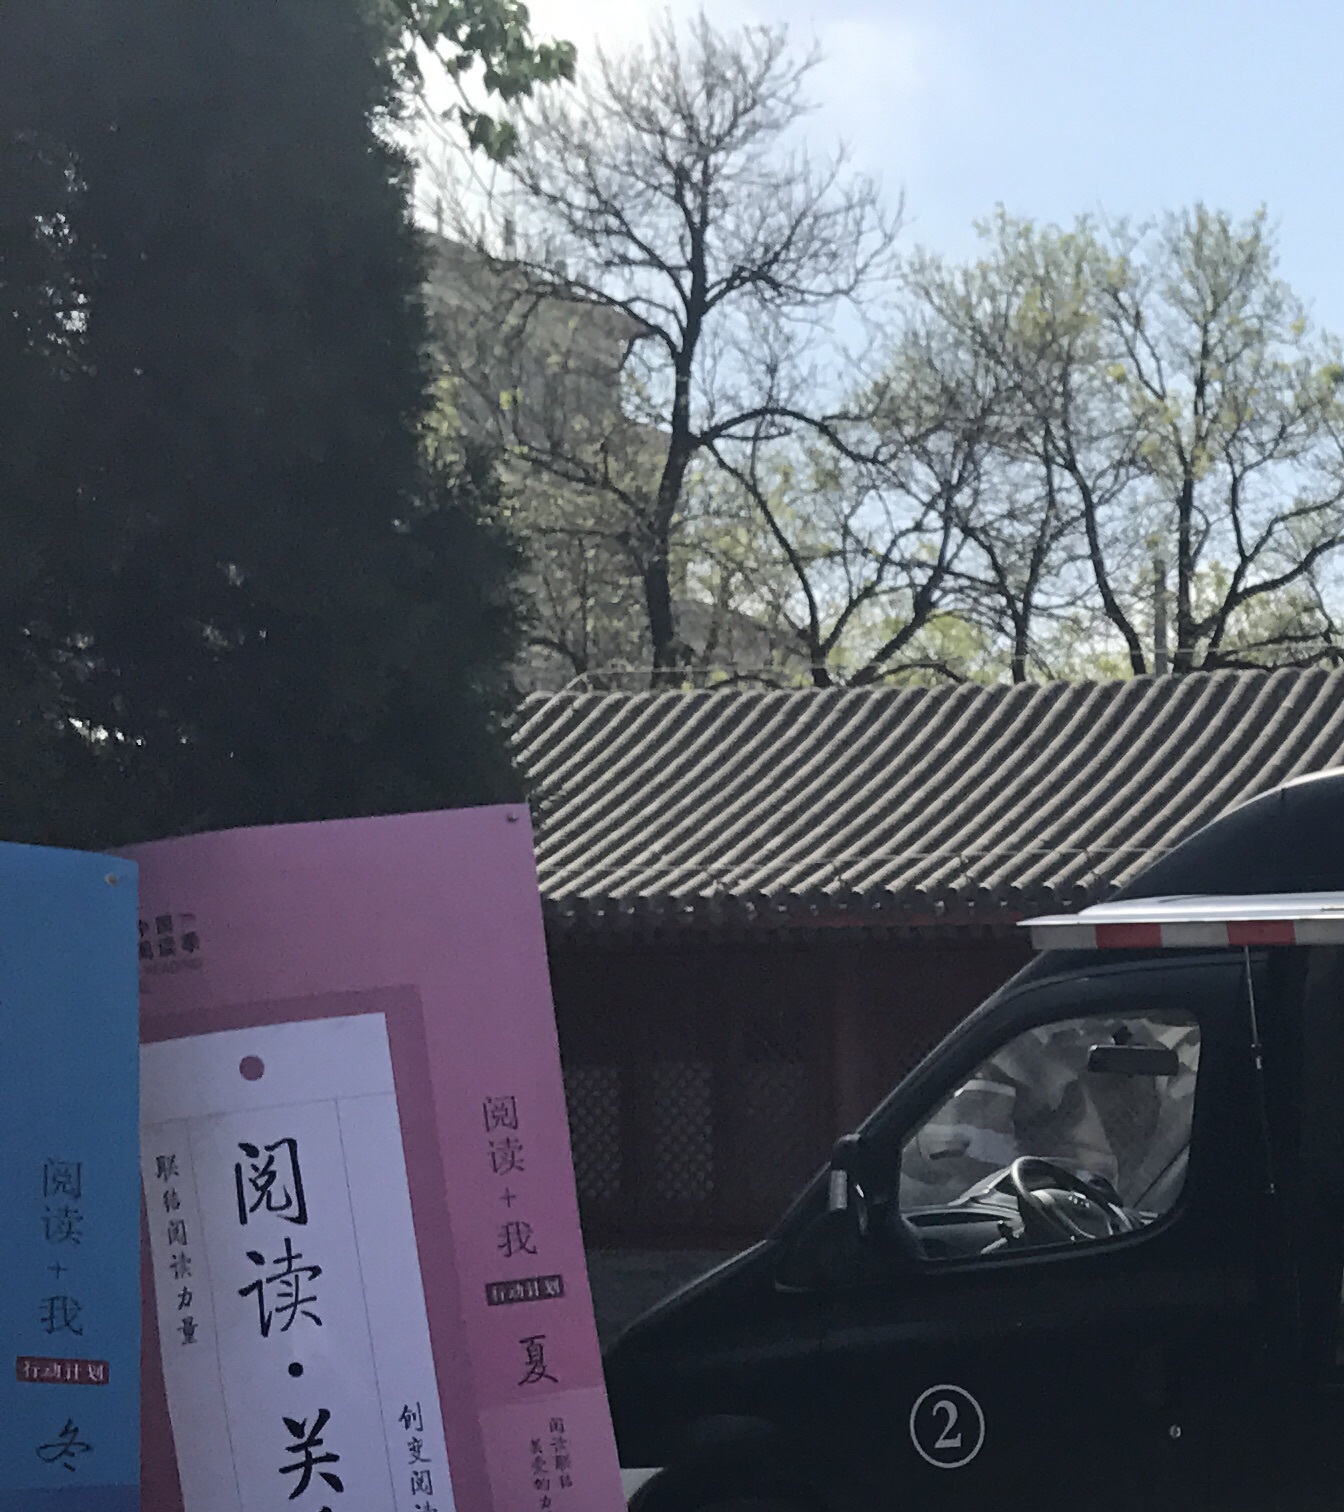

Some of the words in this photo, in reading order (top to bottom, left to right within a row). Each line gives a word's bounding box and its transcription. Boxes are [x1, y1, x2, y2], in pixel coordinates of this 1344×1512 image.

[154, 1155, 198, 1346] 联结阅读力量
[487, 1279, 562, 1304] 行动计划
[21, 1360, 105, 1382] 行动计划
[517, 1335, 559, 1387] 夏
[36, 1418, 94, 1473] 冬
